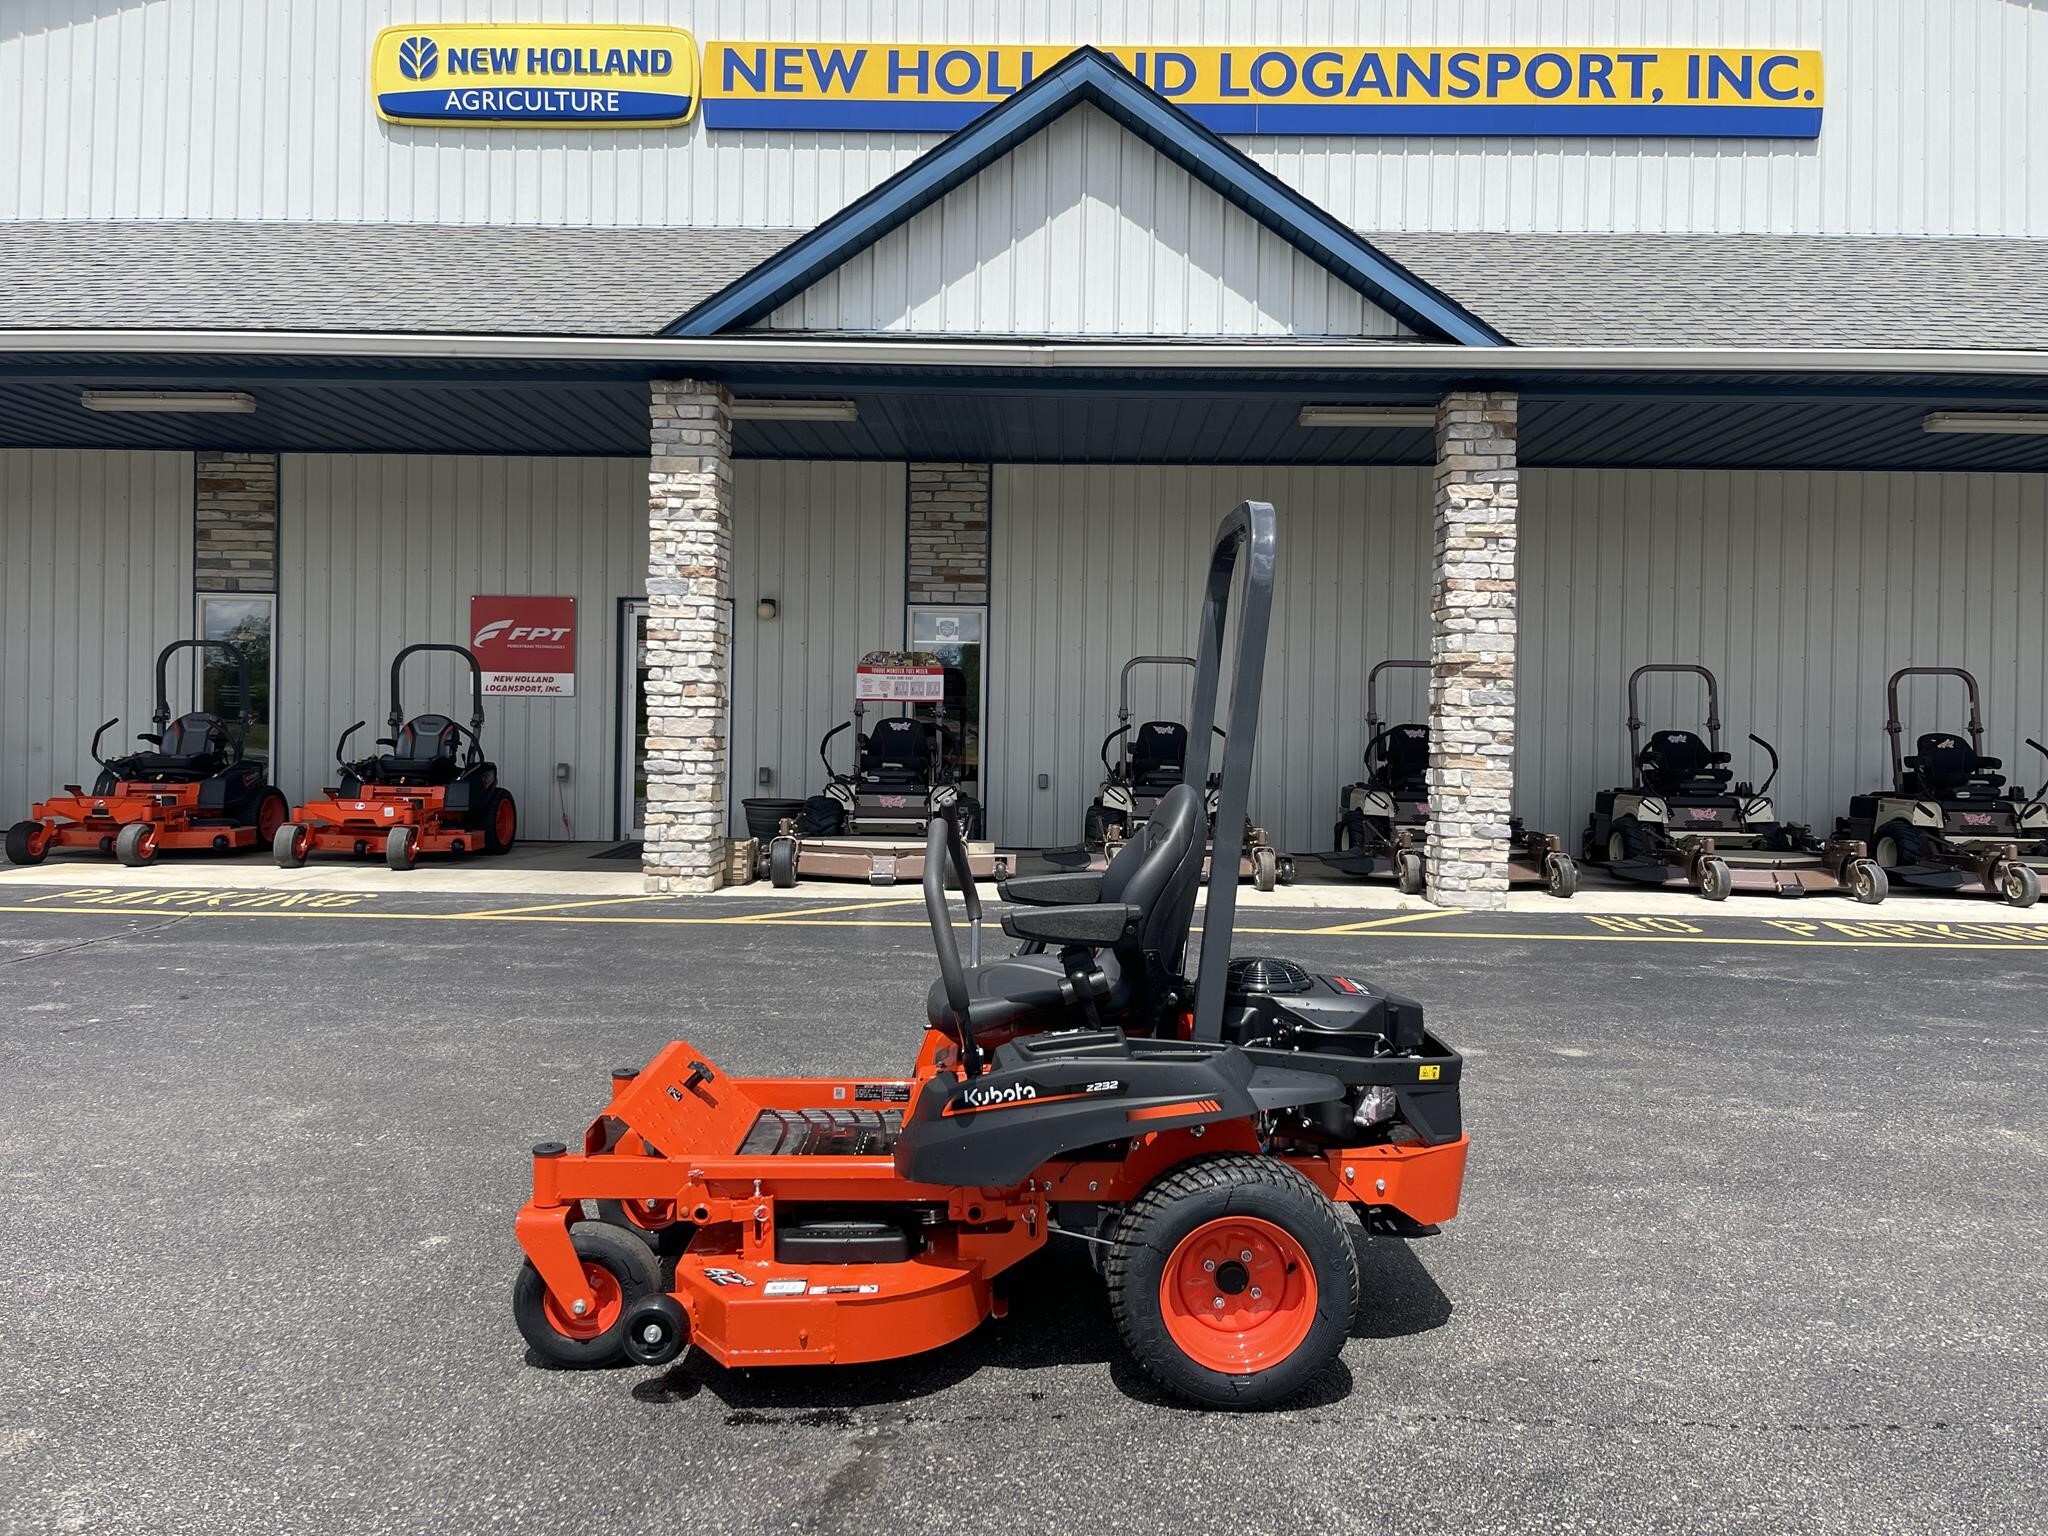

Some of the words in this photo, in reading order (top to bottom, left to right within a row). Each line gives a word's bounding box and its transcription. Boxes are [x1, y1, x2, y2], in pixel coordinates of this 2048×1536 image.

[448, 48, 519, 73] NEW
[527, 48, 673, 76] HOLLAND
[723, 48, 868, 93] NEW
[1220, 52, 1663, 104] LOGANSPORT,
[1688, 55, 1815, 101] INC.
[445, 90, 620, 112] AGRICULTURE
[508, 627, 571, 641] FPT
[493, 675, 513, 683] NEW
[485, 685, 543, 693] LOGANSPORT,
[545, 685, 562, 693] INC.
[24, 888, 378, 907] PARKING
[1584, 915, 1704, 934] NO
[964, 1082, 1037, 1106] Kubota
